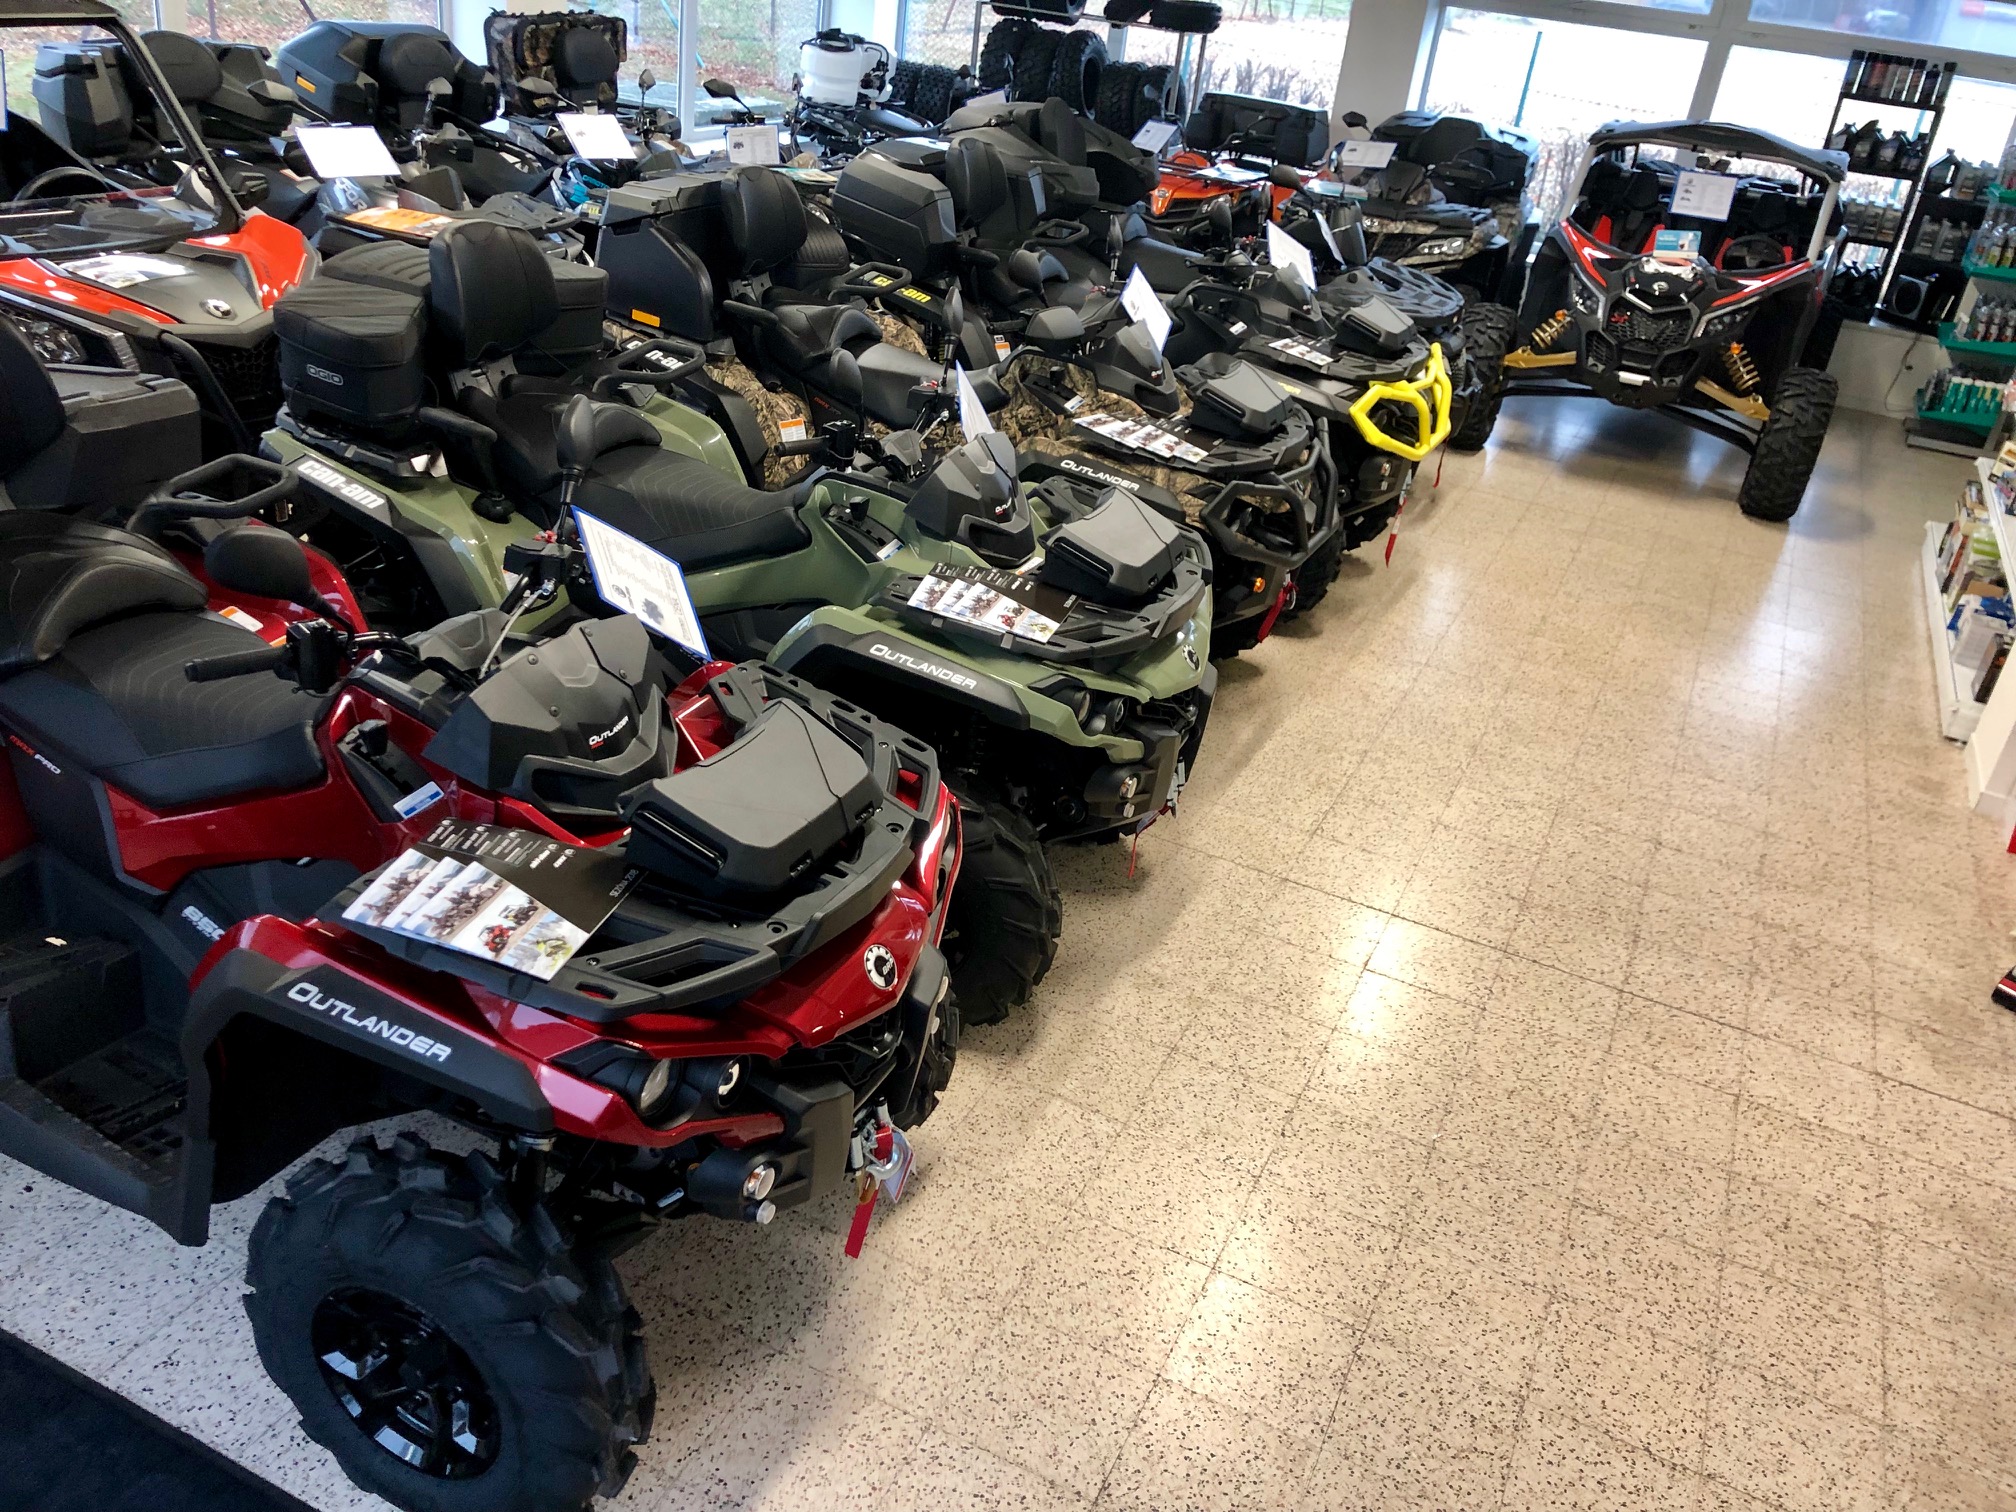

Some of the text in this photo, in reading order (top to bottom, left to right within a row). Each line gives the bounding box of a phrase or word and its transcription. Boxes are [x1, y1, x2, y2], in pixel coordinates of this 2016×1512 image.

[306, 363, 344, 386] OGIO
[297, 460, 386, 510] can-am
[1060, 459, 1140, 492] OUTLANDER
[868, 643, 978, 690] OUTLANDER
[34, 753, 62, 775] PRO
[286, 981, 453, 1063] OUTLANDER
